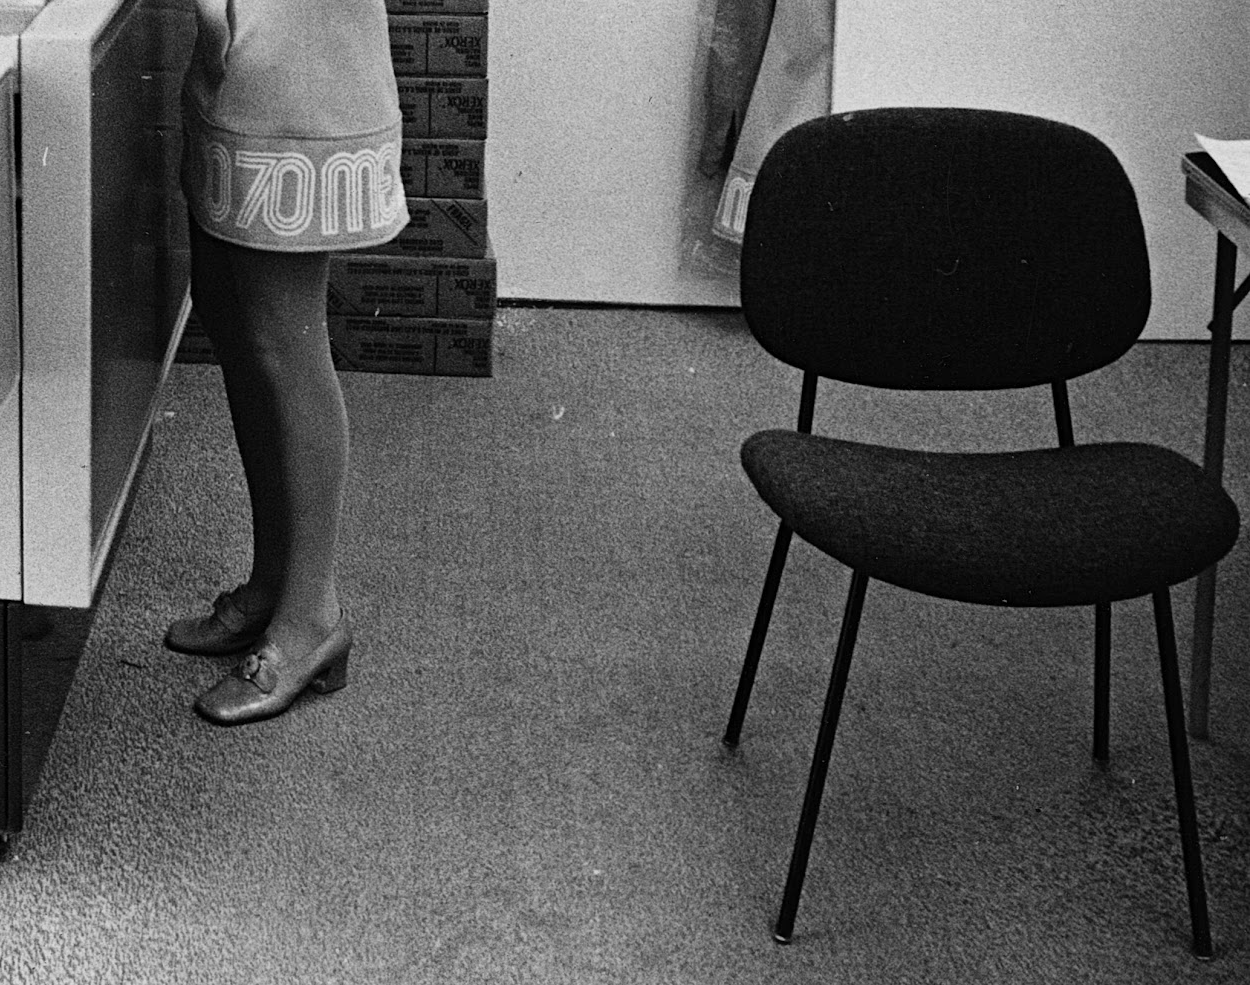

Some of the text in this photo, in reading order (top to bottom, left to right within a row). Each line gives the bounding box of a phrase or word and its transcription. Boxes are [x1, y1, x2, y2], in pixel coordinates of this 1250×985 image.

[444, 36, 481, 48] XEROX
[447, 96, 483, 108] XEROX
[443, 159, 480, 171] XEROX
[235, 150, 316, 236] 70
